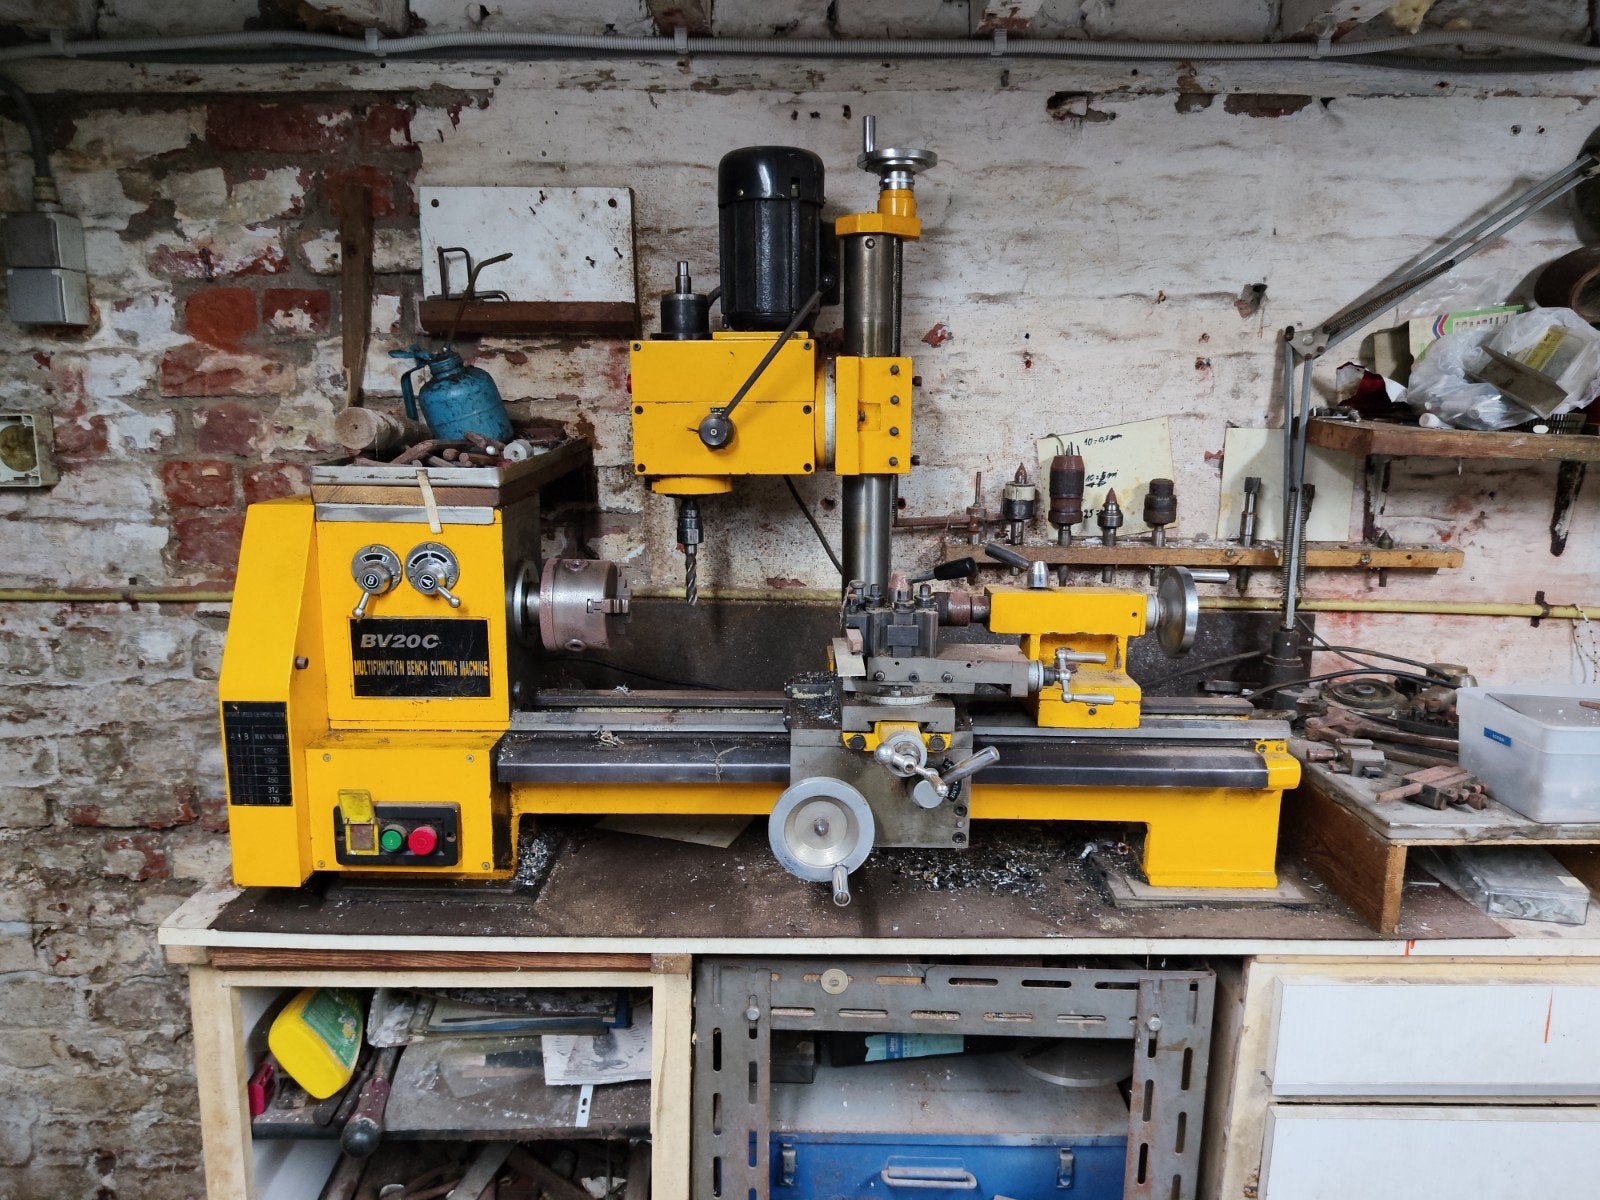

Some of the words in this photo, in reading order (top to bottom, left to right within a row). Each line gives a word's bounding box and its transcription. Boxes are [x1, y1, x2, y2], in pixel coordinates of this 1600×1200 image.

[367, 577, 375, 585] B
[422, 577, 432, 586] A
[360, 633, 440, 649] BV20C
[354, 659, 405, 676] MULTIFUNCTION
[406, 659, 429, 676] BENCH
[430, 660, 458, 676] CUTTING
[459, 660, 489, 677] MACHINE
